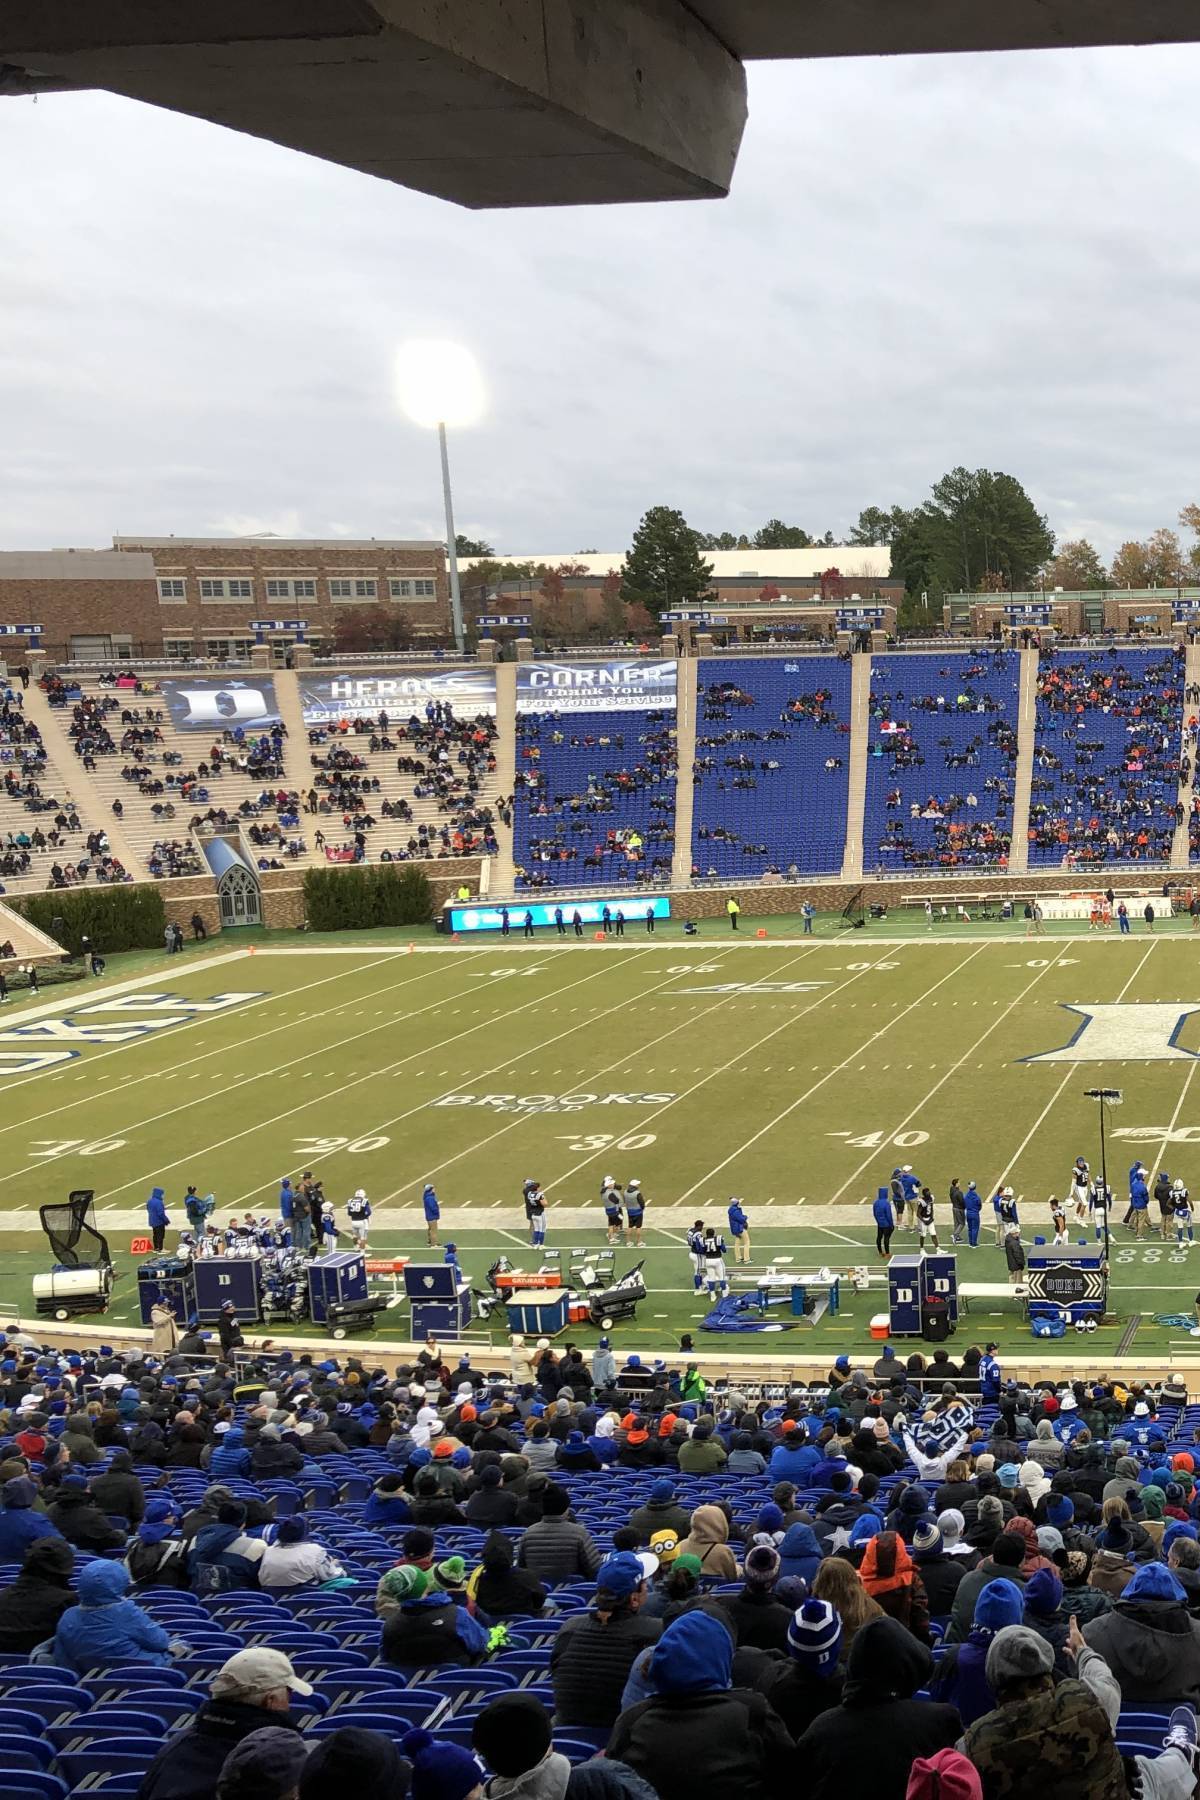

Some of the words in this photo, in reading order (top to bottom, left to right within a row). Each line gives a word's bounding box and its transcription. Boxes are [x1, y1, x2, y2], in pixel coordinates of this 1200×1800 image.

[529, 667, 663, 688] CORNER
[544, 687, 604, 697] Thank
[609, 687, 644, 695] You
[522, 700, 555, 708] For
[558, 698, 602, 708] Your
[606, 694, 673, 706] Service
[432, 1092, 677, 1107] BROOKS
[493, 1105, 585, 1113] FIELD
[294, 1136, 391, 1153] 20
[568, 1134, 657, 1151] 30
[845, 1130, 930, 1147] 40
[28, 1139, 128, 1156] 10
[132, 1240, 147, 1252] 20
[704, 1241, 717, 1252] 74
[218, 1274, 231, 1286] D
[934, 1278, 950, 1293] D
[1046, 1278, 1083, 1291] DUKE
[896, 1288, 913, 1303] D
[929, 1317, 937, 1326] G
[818, 1652, 830, 1665] D
